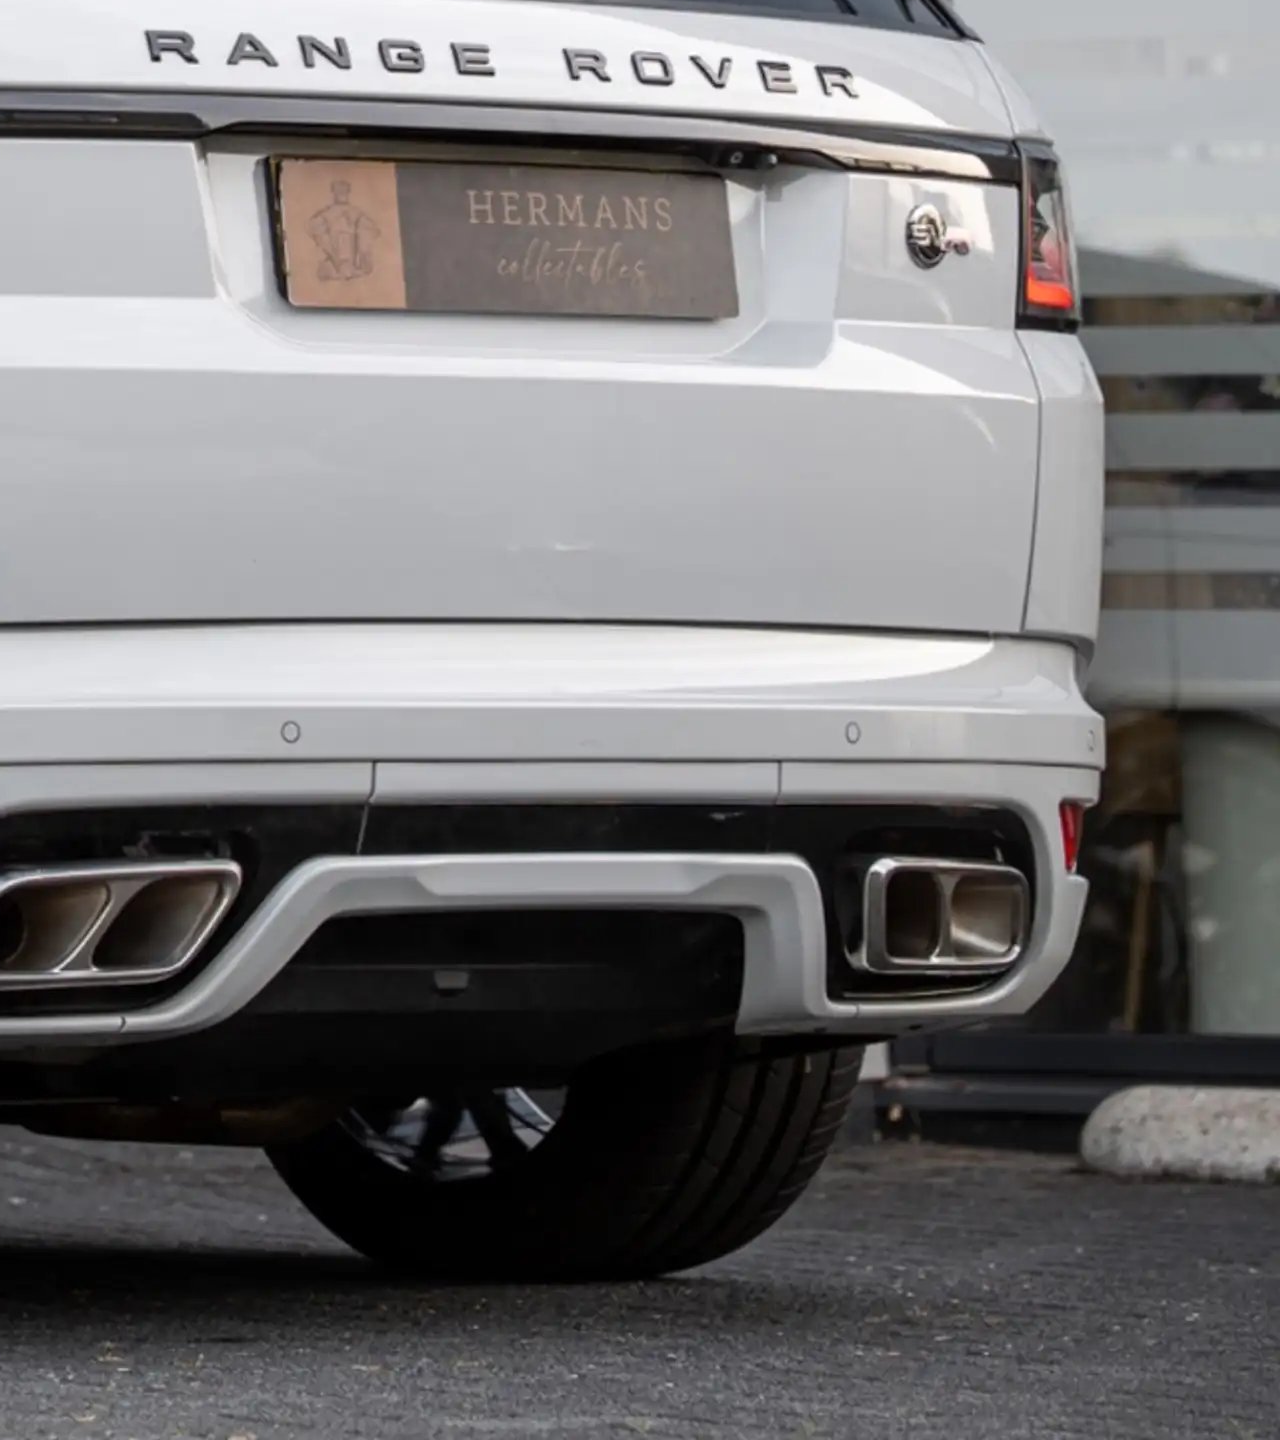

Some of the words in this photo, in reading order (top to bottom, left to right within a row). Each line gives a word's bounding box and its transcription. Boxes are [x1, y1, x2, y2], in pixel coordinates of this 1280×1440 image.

[143, 29, 497, 77] RANGE
[561, 47, 861, 99] ROVER
[465, 189, 674, 231] HERMANS
[496, 236, 646, 289] collectables
